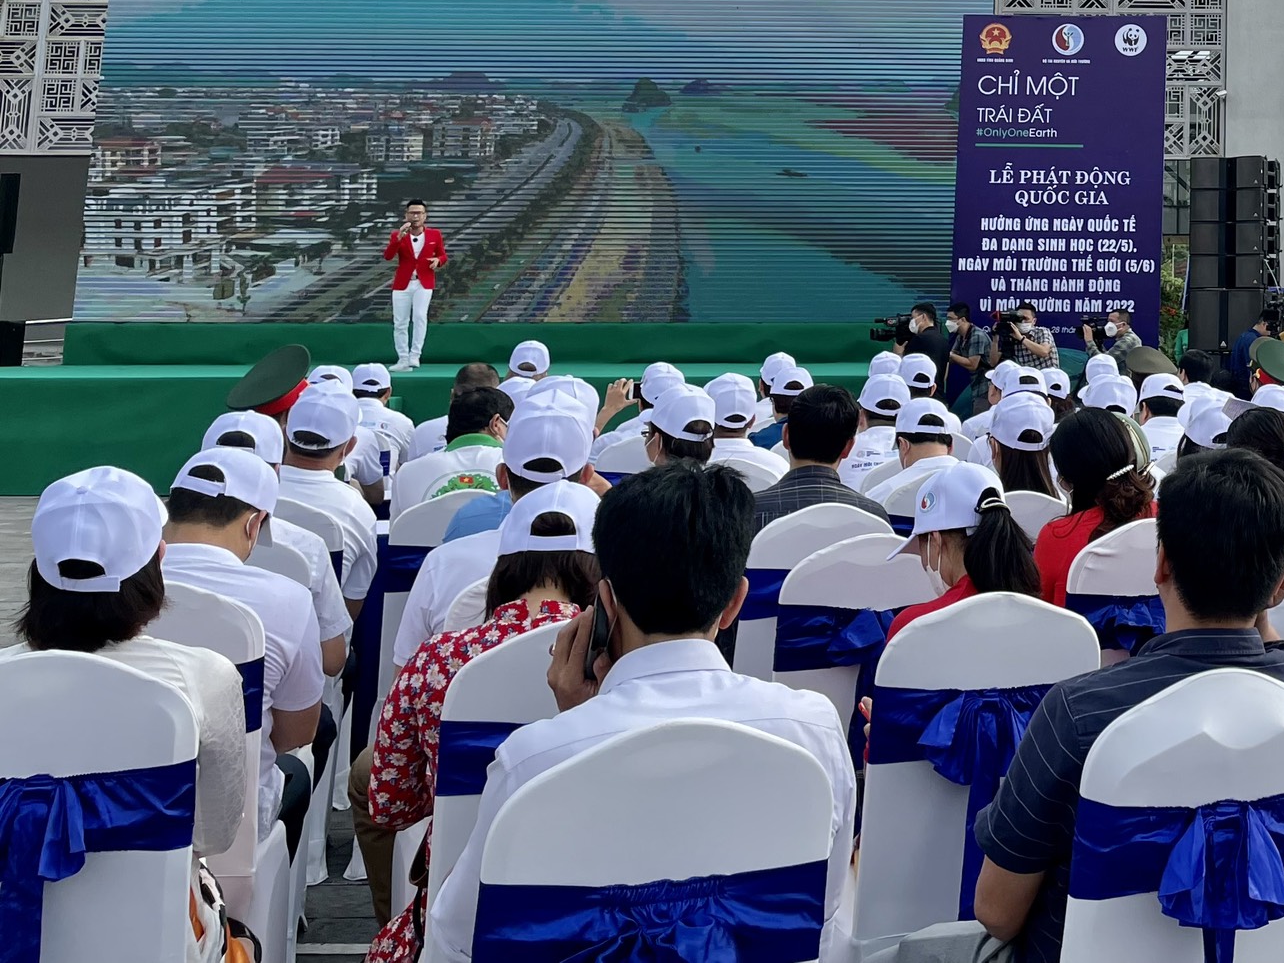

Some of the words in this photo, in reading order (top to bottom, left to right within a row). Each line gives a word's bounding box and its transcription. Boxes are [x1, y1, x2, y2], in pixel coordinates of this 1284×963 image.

[977, 69, 1020, 95] CHỈ
[1026, 72, 1080, 100] MỘT
[976, 104, 1013, 123] TRÁI
[1017, 103, 1053, 123] ĐẤT
[976, 127, 1058, 139] #OnlyOneEarth
[989, 162, 1014, 184] LỄ
[1018, 166, 1071, 185] PHÁT
[1075, 166, 1131, 188] ĐỘNG
[1014, 185, 1070, 207] QUỐC
[1074, 190, 1109, 205] GIA
[980, 214, 1021, 232] HƯỞNG
[1025, 215, 1049, 232] ỨNG
[1052, 215, 1084, 232] NGÀY
[1087, 214, 1119, 233] QUỐC
[1122, 214, 1136, 232] TẾ
[981, 237, 998, 251] ĐA
[1001, 238, 1034, 254] DẠNG
[1037, 238, 1066, 252] SINH
[1069, 238, 1094, 254] HỌC
[958, 255, 989, 271] NGÀY
[992, 255, 1017, 271] MÔI
[1021, 256, 1068, 272] TRƯỜNG
[1071, 254, 1093, 272] THẾ
[1096, 256, 1121, 273] GIỚI
[1125, 259, 1155, 274] (5/6)
[990, 276, 1007, 292] VÀ
[1010, 276, 1048, 292] THÁNG
[1052, 276, 1084, 292] HÀNH
[1088, 277, 1121, 295] ĐỘNG
[979, 296, 992, 312] VÌ
[996, 296, 1020, 312] MÔI
[1074, 297, 1102, 312] NĂM
[1105, 300, 1135, 313] 2022
